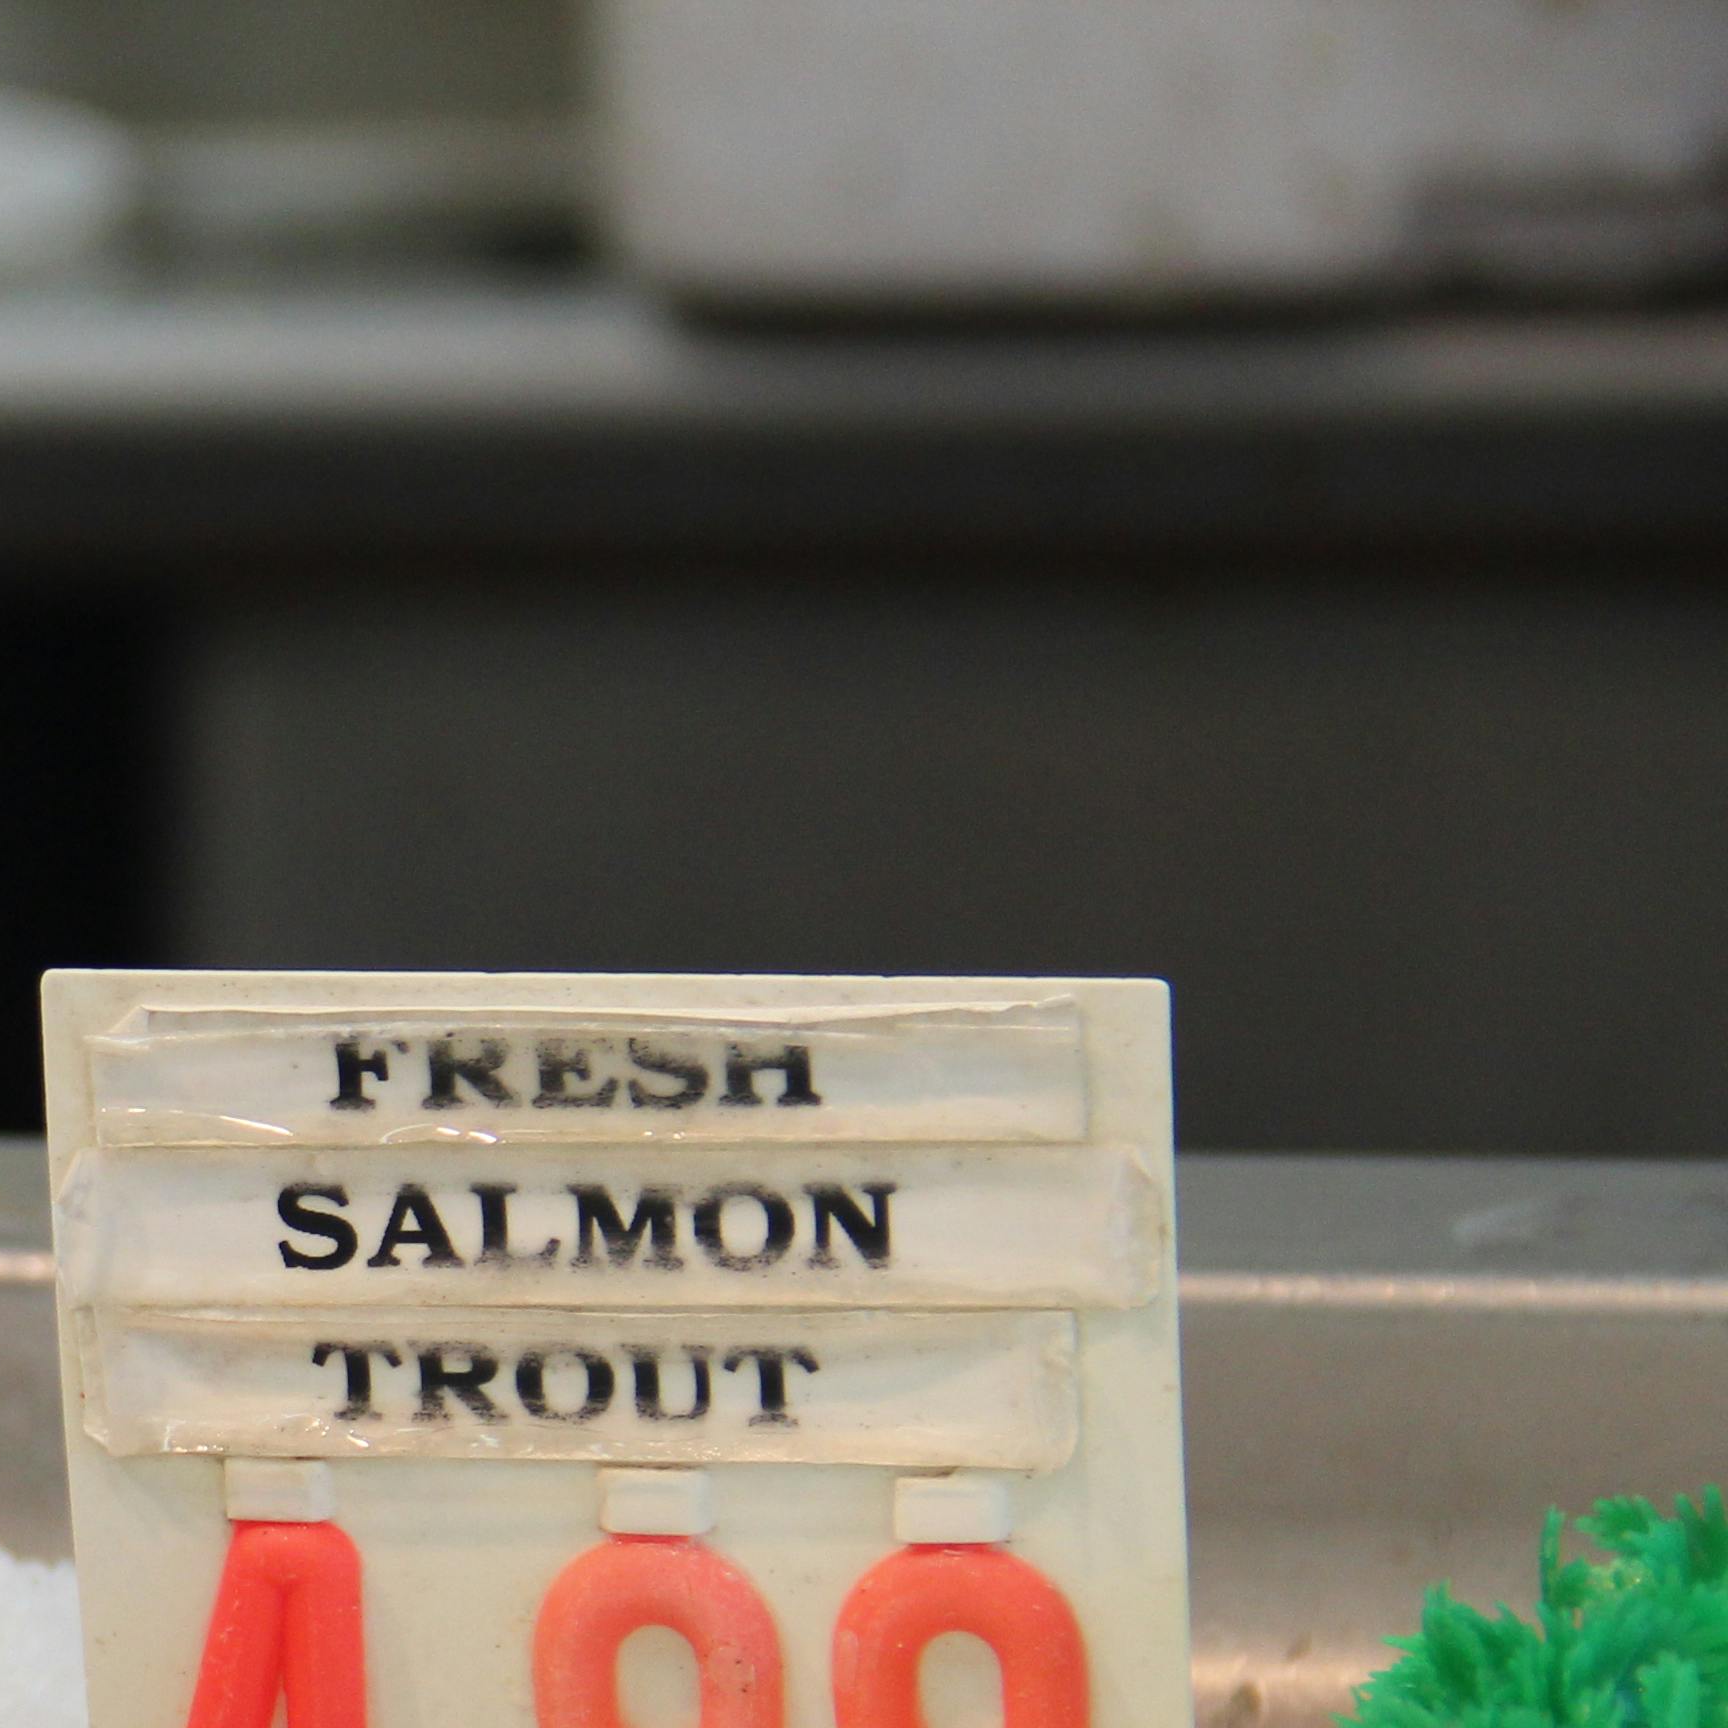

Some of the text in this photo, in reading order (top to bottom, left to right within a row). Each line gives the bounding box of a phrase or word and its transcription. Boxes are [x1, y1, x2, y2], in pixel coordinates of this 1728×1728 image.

[328, 1033, 823, 1112] FRESH
[275, 1180, 897, 1271] SALMON
[312, 1340, 822, 1426] TROUT
